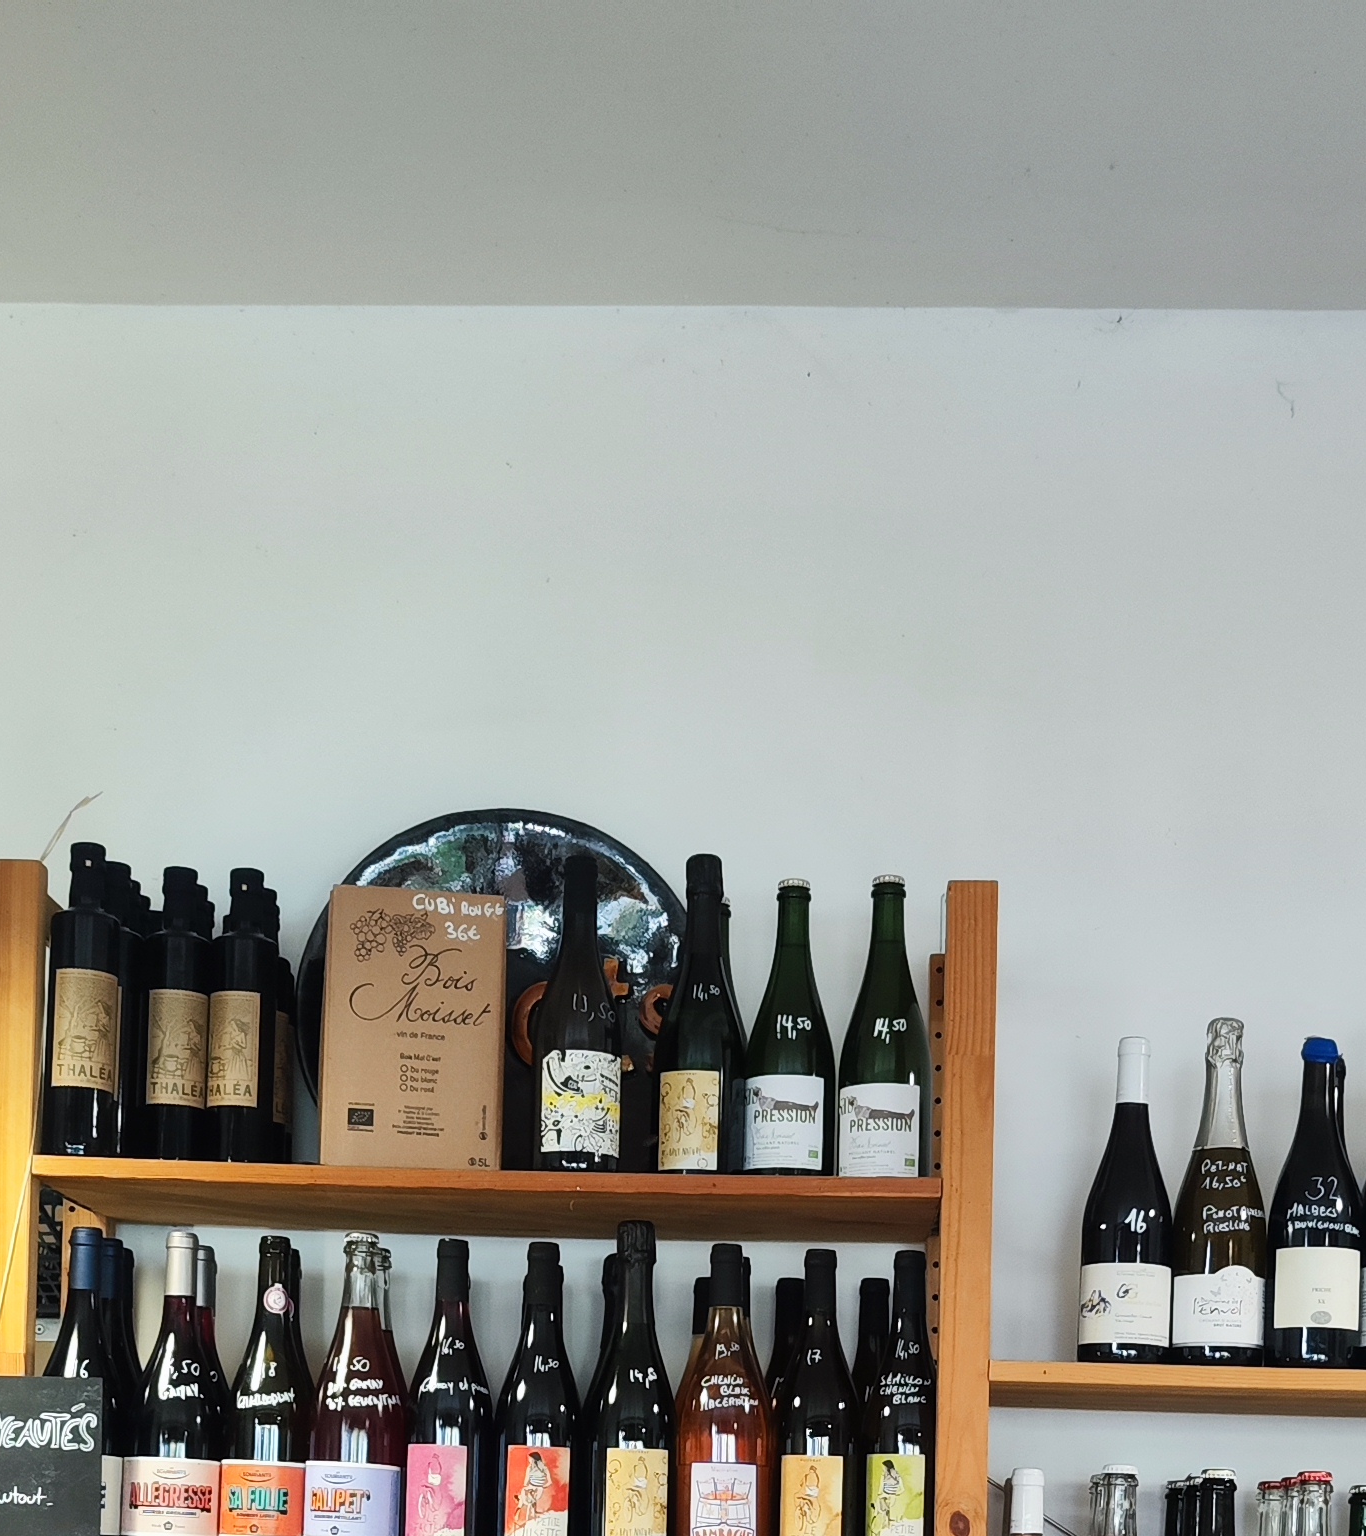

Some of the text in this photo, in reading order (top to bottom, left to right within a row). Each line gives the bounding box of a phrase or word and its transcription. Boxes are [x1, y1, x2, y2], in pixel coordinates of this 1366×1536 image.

[444, 921, 481, 941] 36€
[401, 944, 477, 992] Bois
[349, 982, 491, 1027] Moisset
[775, 1014, 813, 1040] 14,50
[874, 1017, 908, 1044] 14,50
[57, 1063, 113, 1084] THALÉA
[150, 1080, 204, 1098] THALÉA
[208, 1080, 253, 1097] HALÉA
[753, 1108, 817, 1125] PRESSION
[849, 1116, 913, 1134] PRESSION
[477, 1158, 490, 1167] 5L
[1305, 1176, 1339, 1200] 32
[1124, 1208, 1147, 1233] 16
[807, 1349, 823, 1365] 17
[130, 1480, 213, 1513] ALLÉGRESSE
[228, 1486, 289, 1514] SA FOLIE
